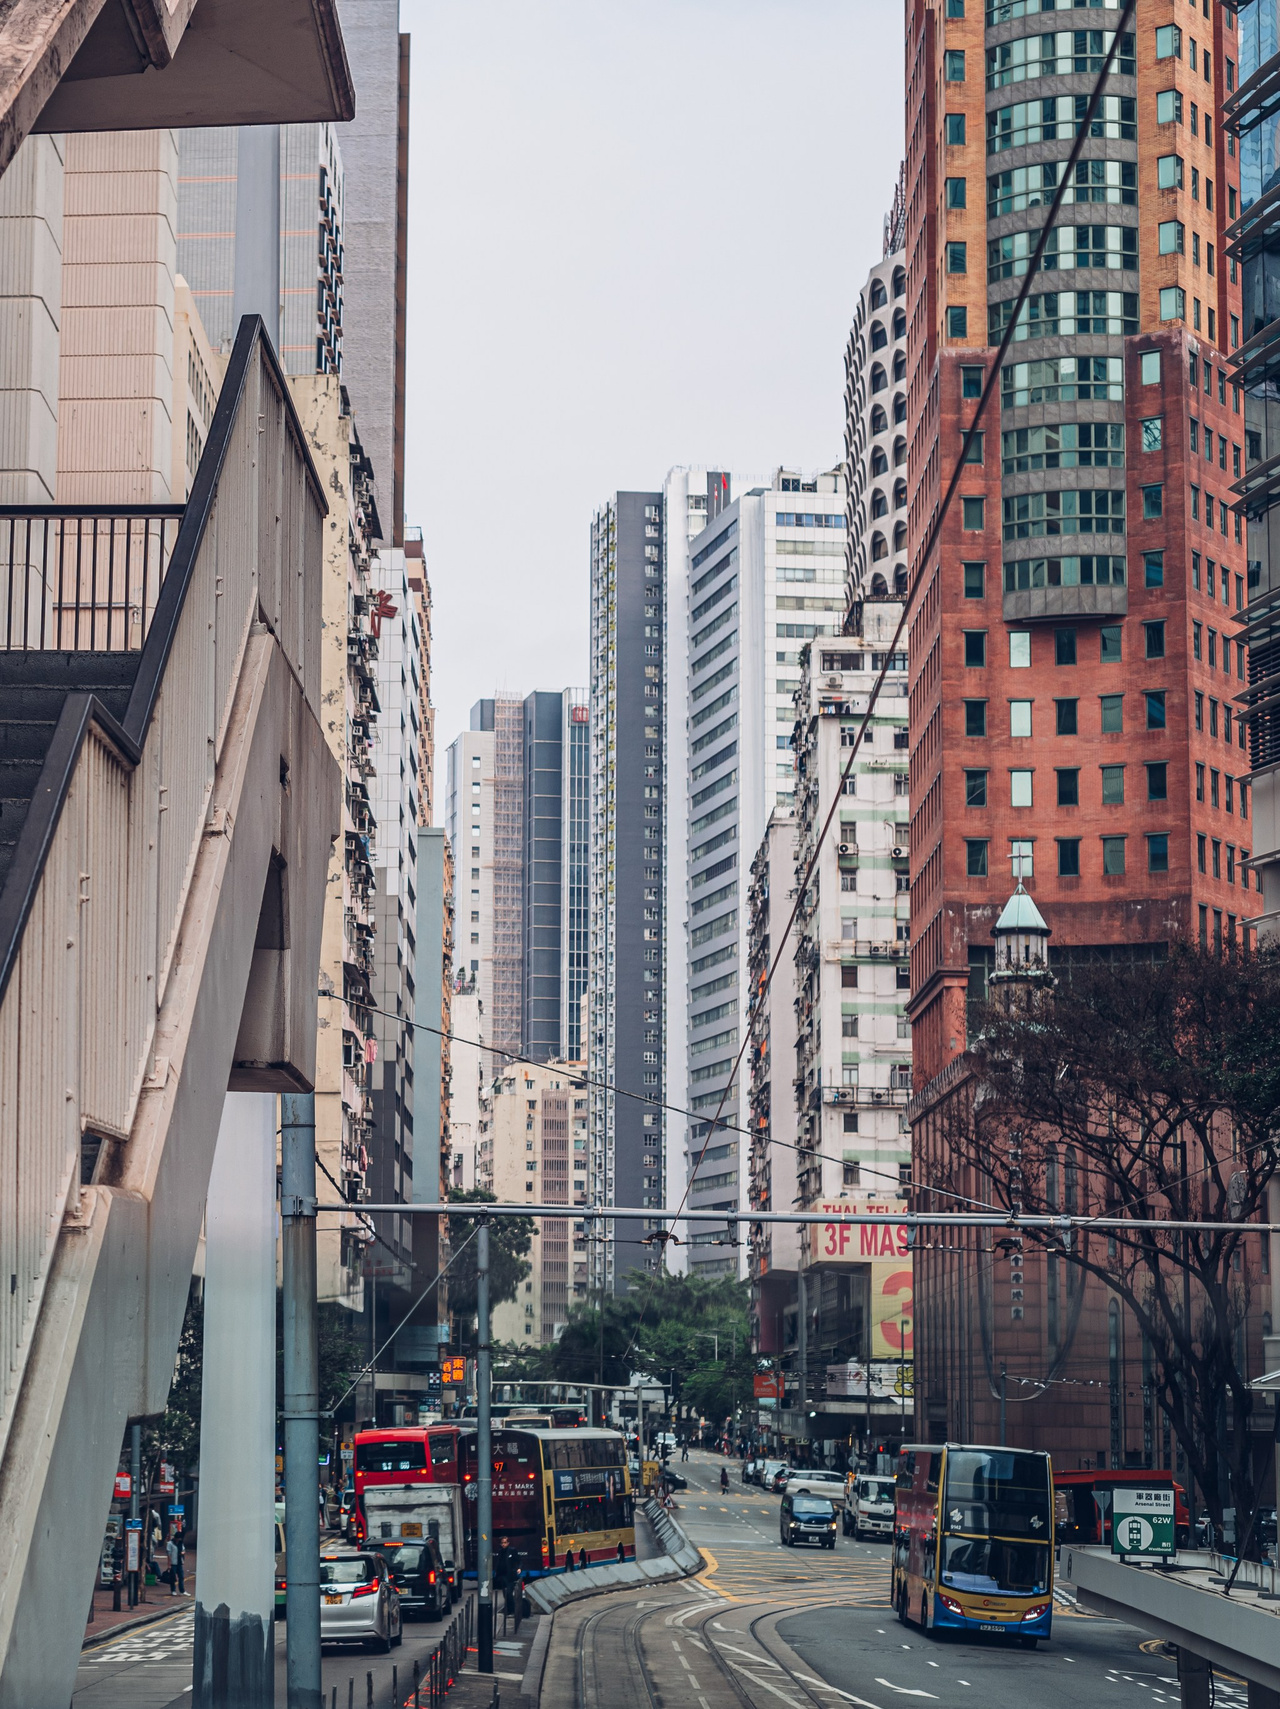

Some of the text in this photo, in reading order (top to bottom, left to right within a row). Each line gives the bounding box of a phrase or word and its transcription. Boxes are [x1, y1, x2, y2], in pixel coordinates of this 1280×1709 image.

[824, 1223, 910, 1257] 3F MAS
[881, 1271, 913, 1351] 3
[493, 1461, 504, 1472] 97
[1152, 1516, 1171, 1524] 62W
